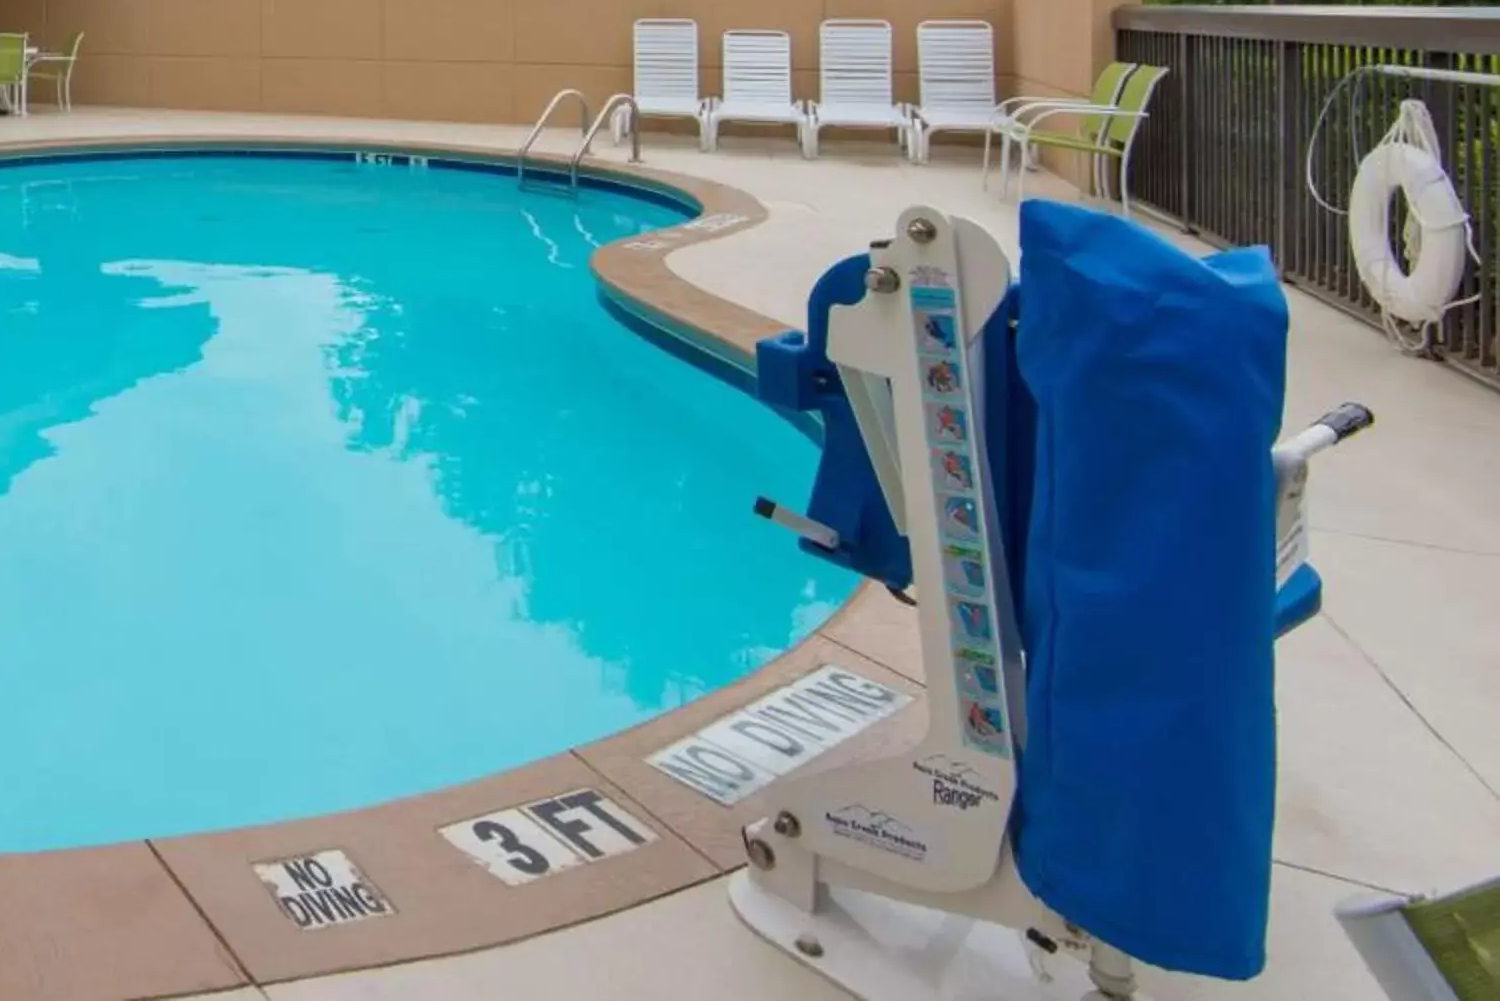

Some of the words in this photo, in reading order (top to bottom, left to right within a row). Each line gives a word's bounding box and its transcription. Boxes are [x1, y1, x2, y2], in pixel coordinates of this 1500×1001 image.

[660, 744, 755, 798] NO
[730, 672, 897, 757] DIVING
[933, 778, 982, 810] Ranger
[473, 819, 551, 876] 3
[527, 789, 649, 859] FT
[284, 858, 334, 893] NO
[281, 882, 387, 928] DIVING
